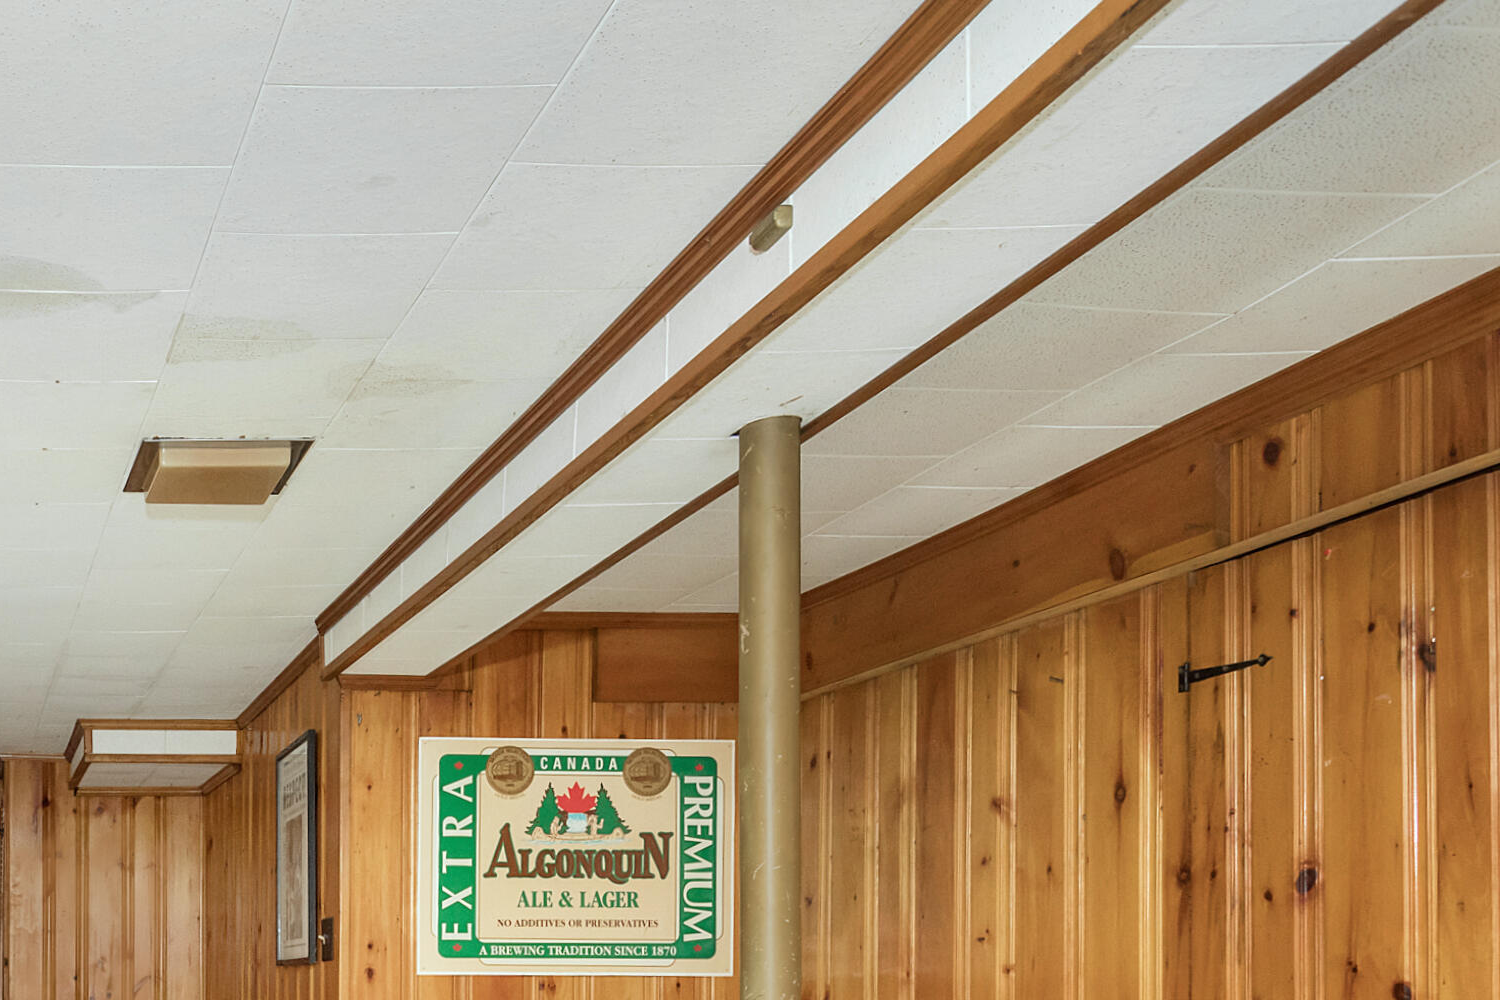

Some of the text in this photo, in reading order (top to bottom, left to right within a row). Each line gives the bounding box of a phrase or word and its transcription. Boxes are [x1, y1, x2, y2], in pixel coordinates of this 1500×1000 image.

[540, 756, 618, 771] CANADA
[441, 775, 473, 941] EXTRA
[483, 822, 674, 885] ALGONQUIN
[682, 775, 713, 943] PREMIUM
[517, 890, 640, 908] ALE & LAGER
[497, 919, 659, 928] NO ADDITIVES OR PRESERVATIVES
[479, 946, 677, 956] A BREWING TRADITION SINCE 1870
